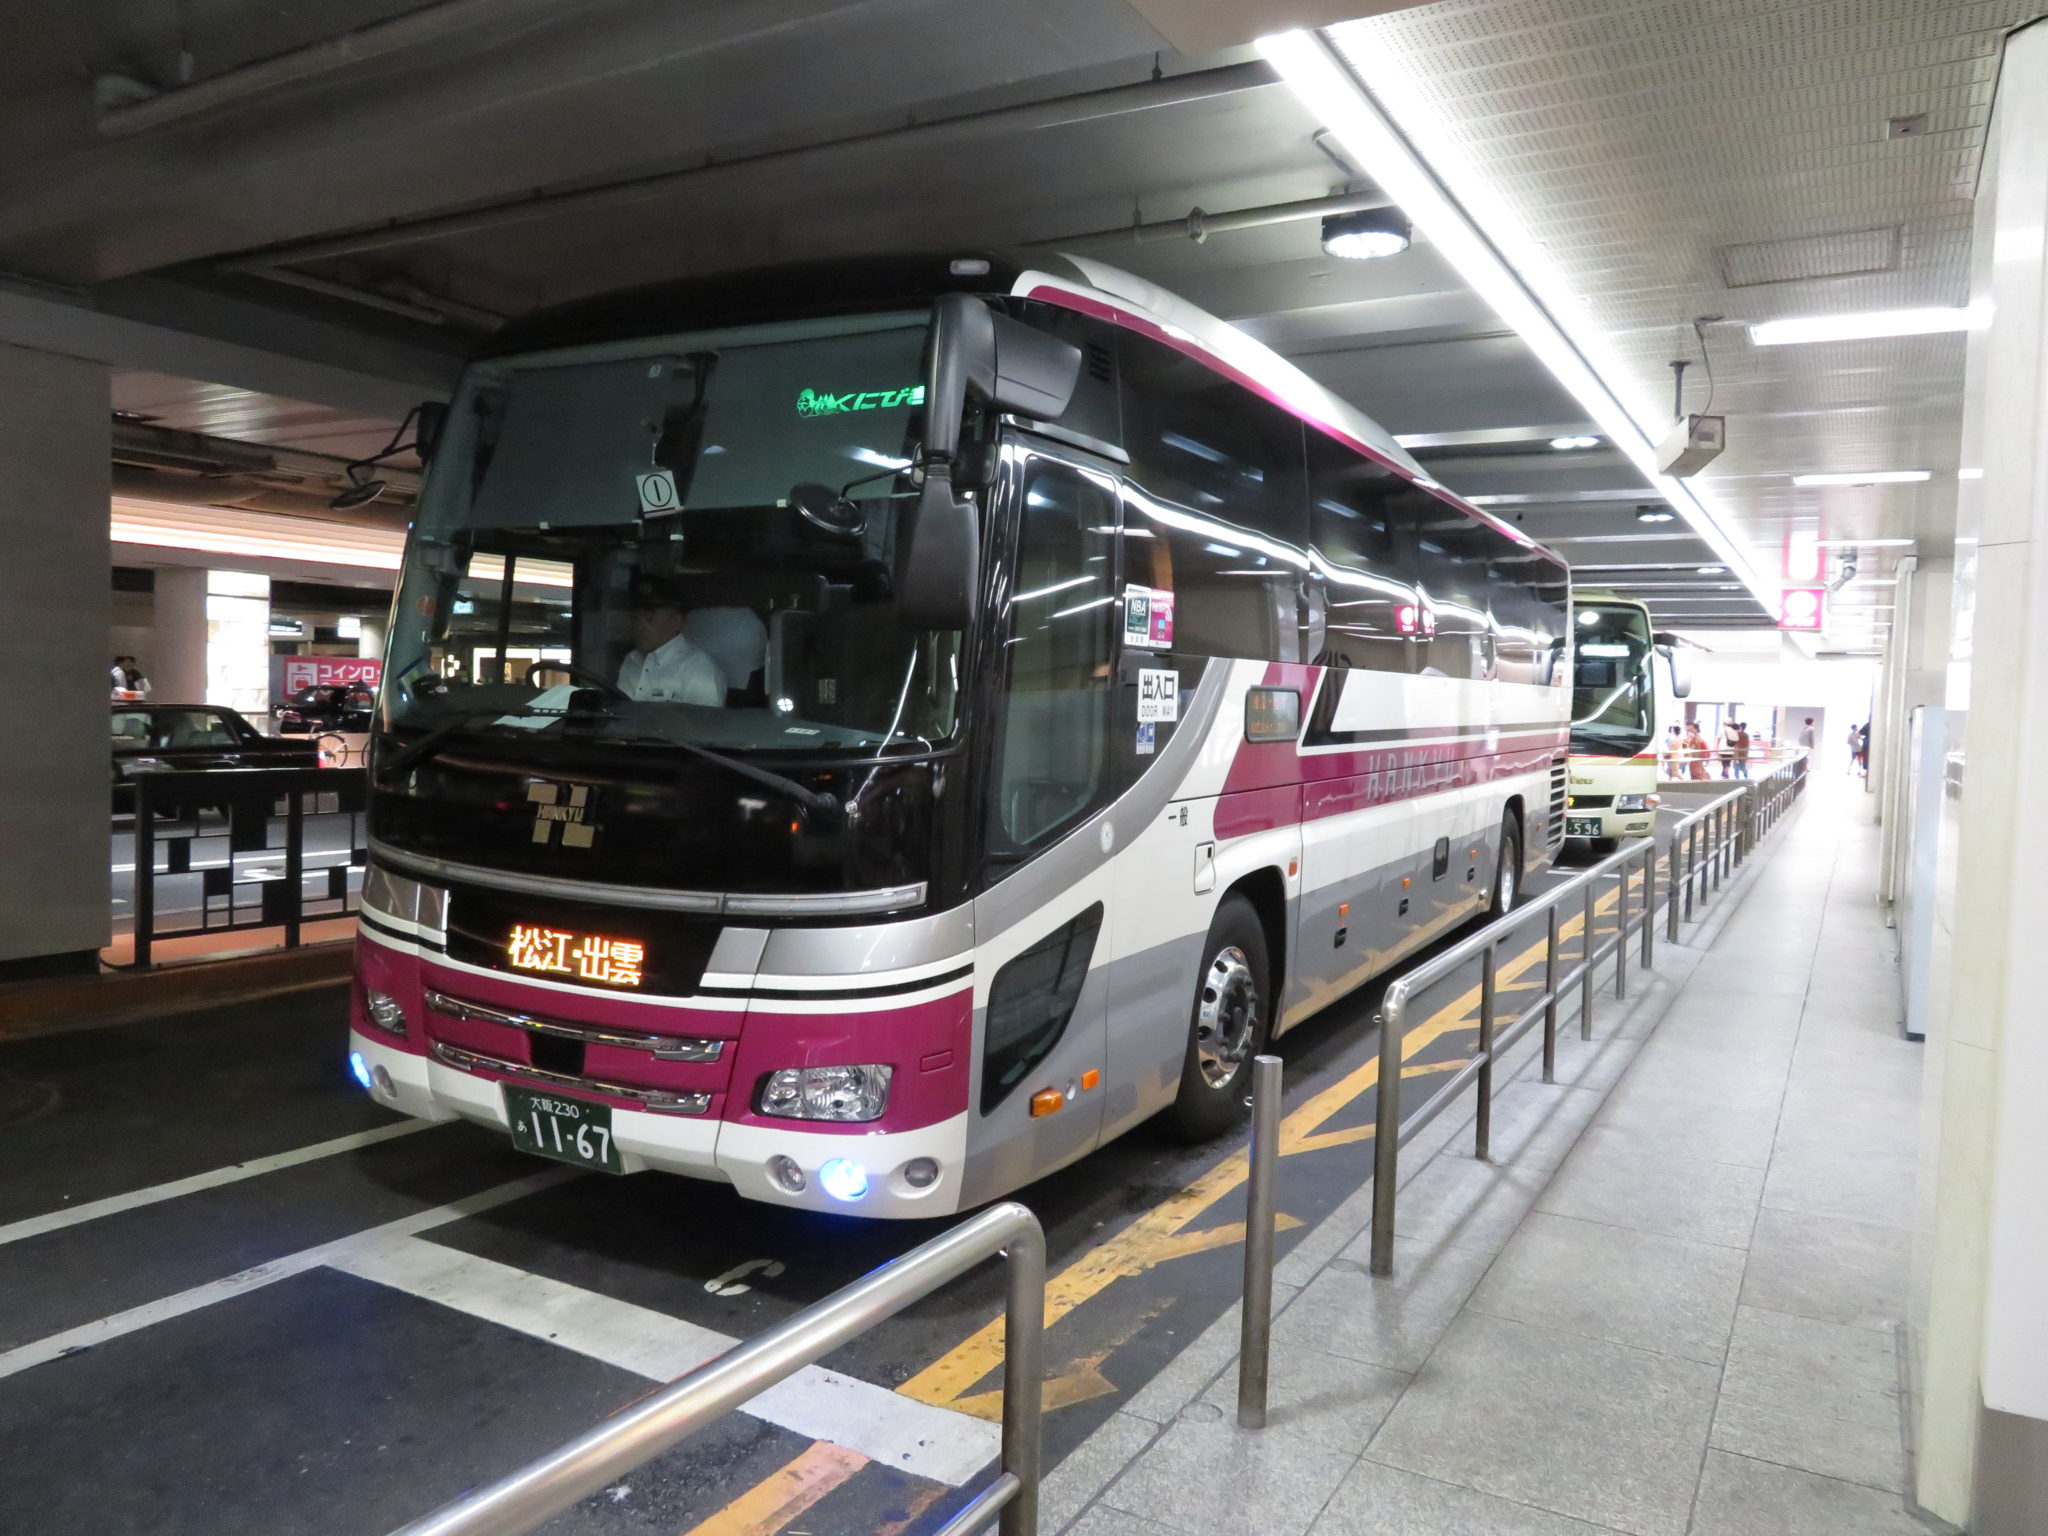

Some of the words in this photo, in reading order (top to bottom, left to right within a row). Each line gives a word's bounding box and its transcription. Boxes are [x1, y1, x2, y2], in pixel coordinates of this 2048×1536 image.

[1131, 598, 1147, 613] NBA
[319, 664, 381, 680] コインロ
[1142, 674, 1175, 701] 出入口
[1141, 704, 1158, 718] DOOR
[1162, 704, 1174, 717] WAY
[1367, 746, 1457, 800] HANKYU
[536, 803, 585, 823] HANKYU
[1168, 806, 1189, 827] 一般
[508, 924, 644, 986] 松江・出雲
